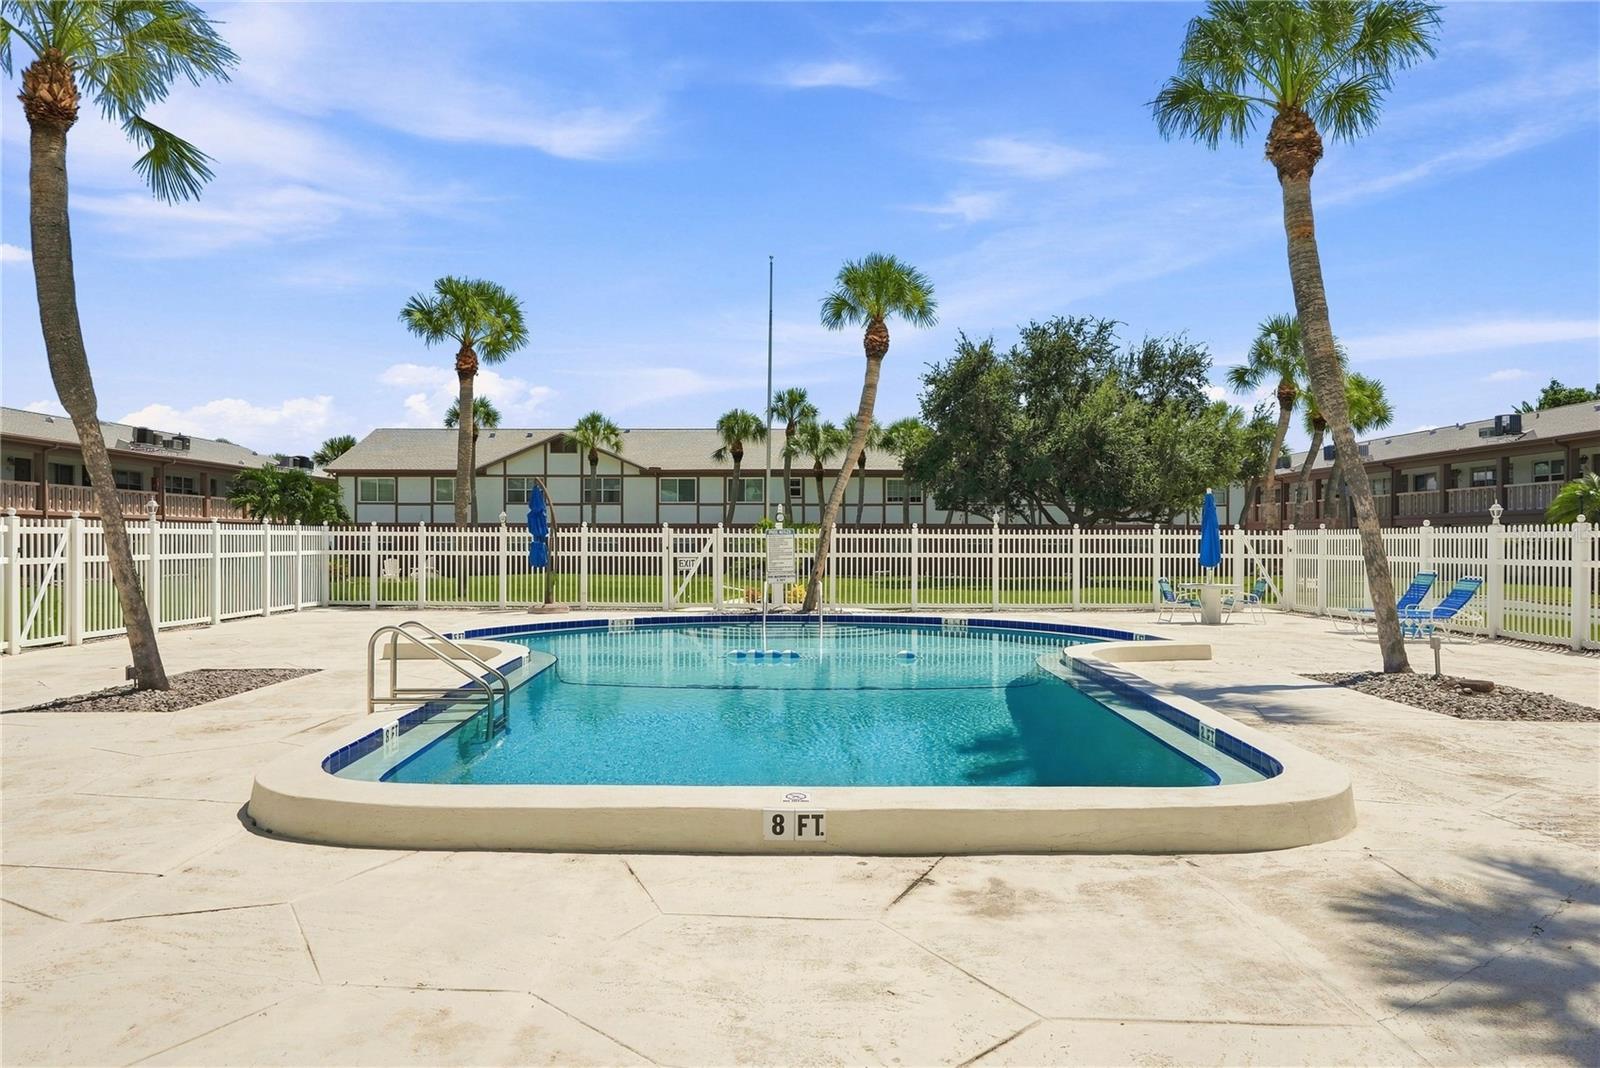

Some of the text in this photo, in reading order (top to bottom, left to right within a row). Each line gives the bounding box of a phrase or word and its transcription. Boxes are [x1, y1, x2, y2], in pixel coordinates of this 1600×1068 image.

[679, 559, 696, 568] EXIT
[772, 814, 824, 837] 8 FT.
